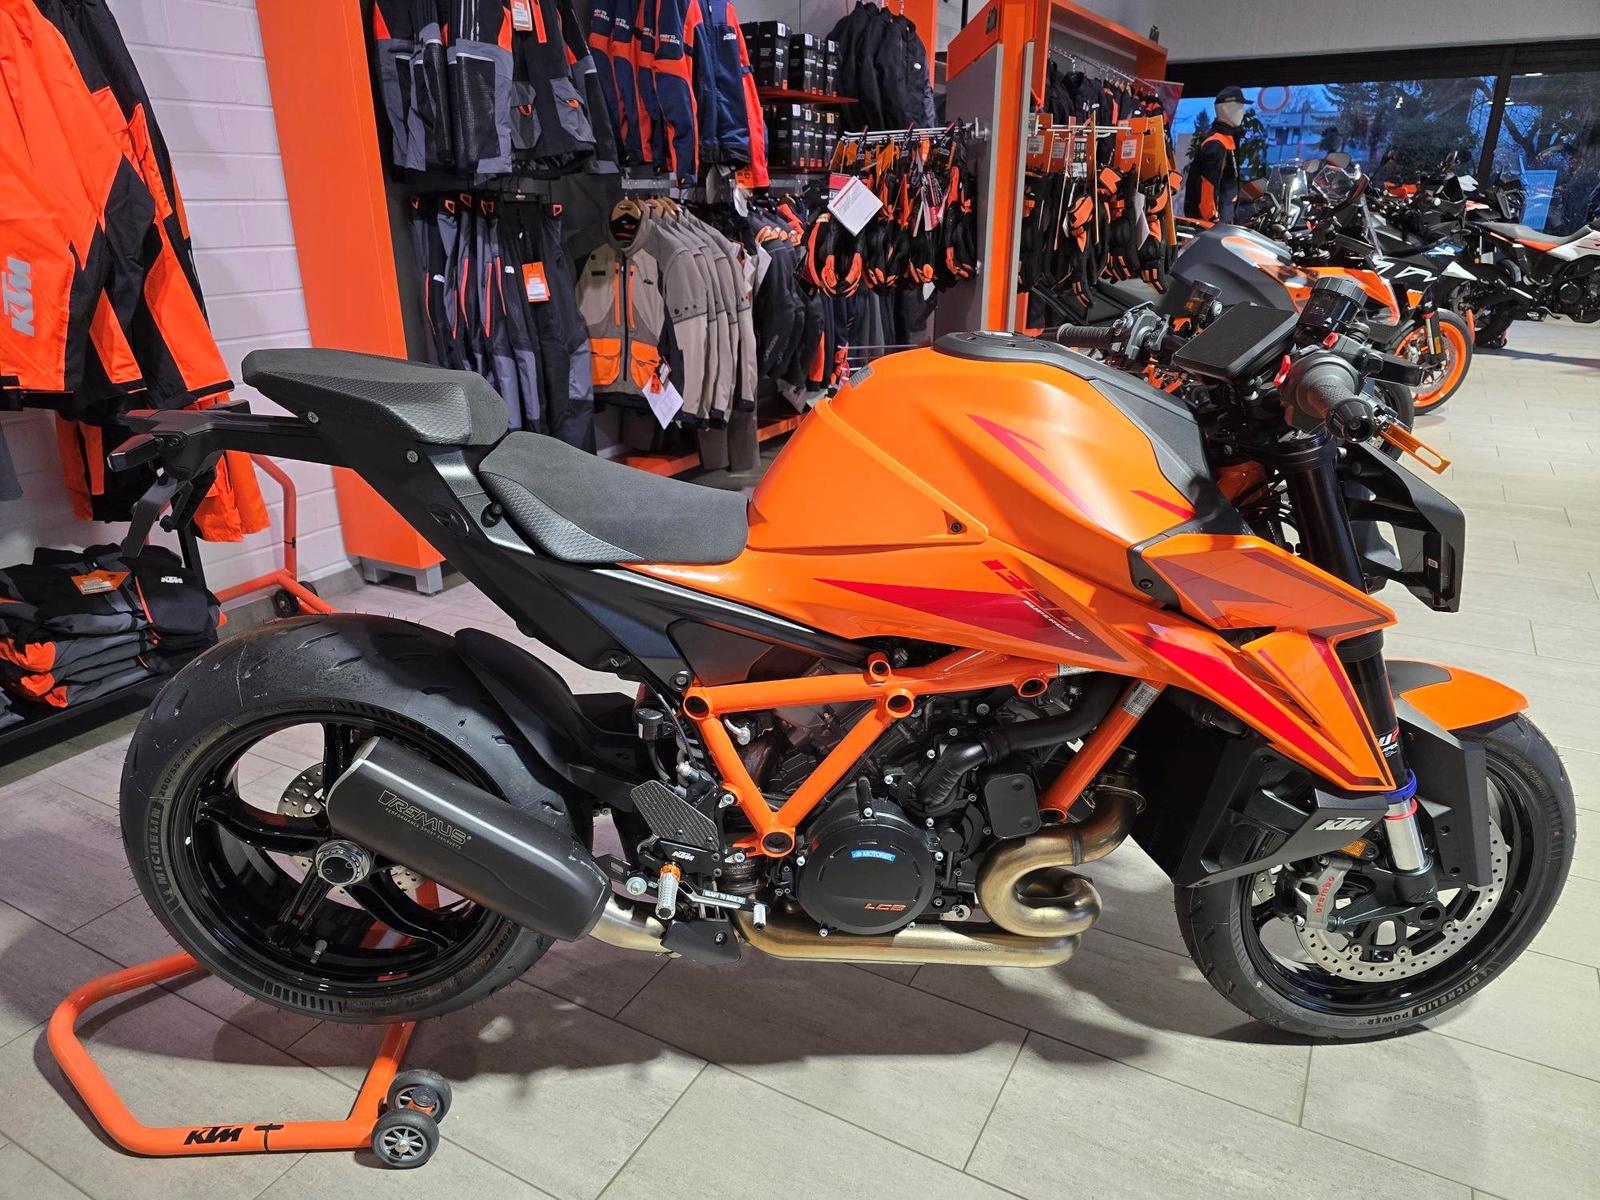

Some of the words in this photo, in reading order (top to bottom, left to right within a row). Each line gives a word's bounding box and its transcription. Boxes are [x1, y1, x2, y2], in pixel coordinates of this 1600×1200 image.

[1, 256, 35, 337] KTM
[160, 575, 184, 584] KTM
[387, 797, 467, 845] REMUS
[1314, 817, 1373, 831] KTM
[149, 807, 168, 885] MICHELIN
[671, 850, 695, 861] KTM
[1311, 875, 1336, 914] brembo
[1418, 976, 1480, 1015] MICHELIN
[1367, 1012, 1410, 1025] POWER
[183, 1125, 244, 1145] KTM
